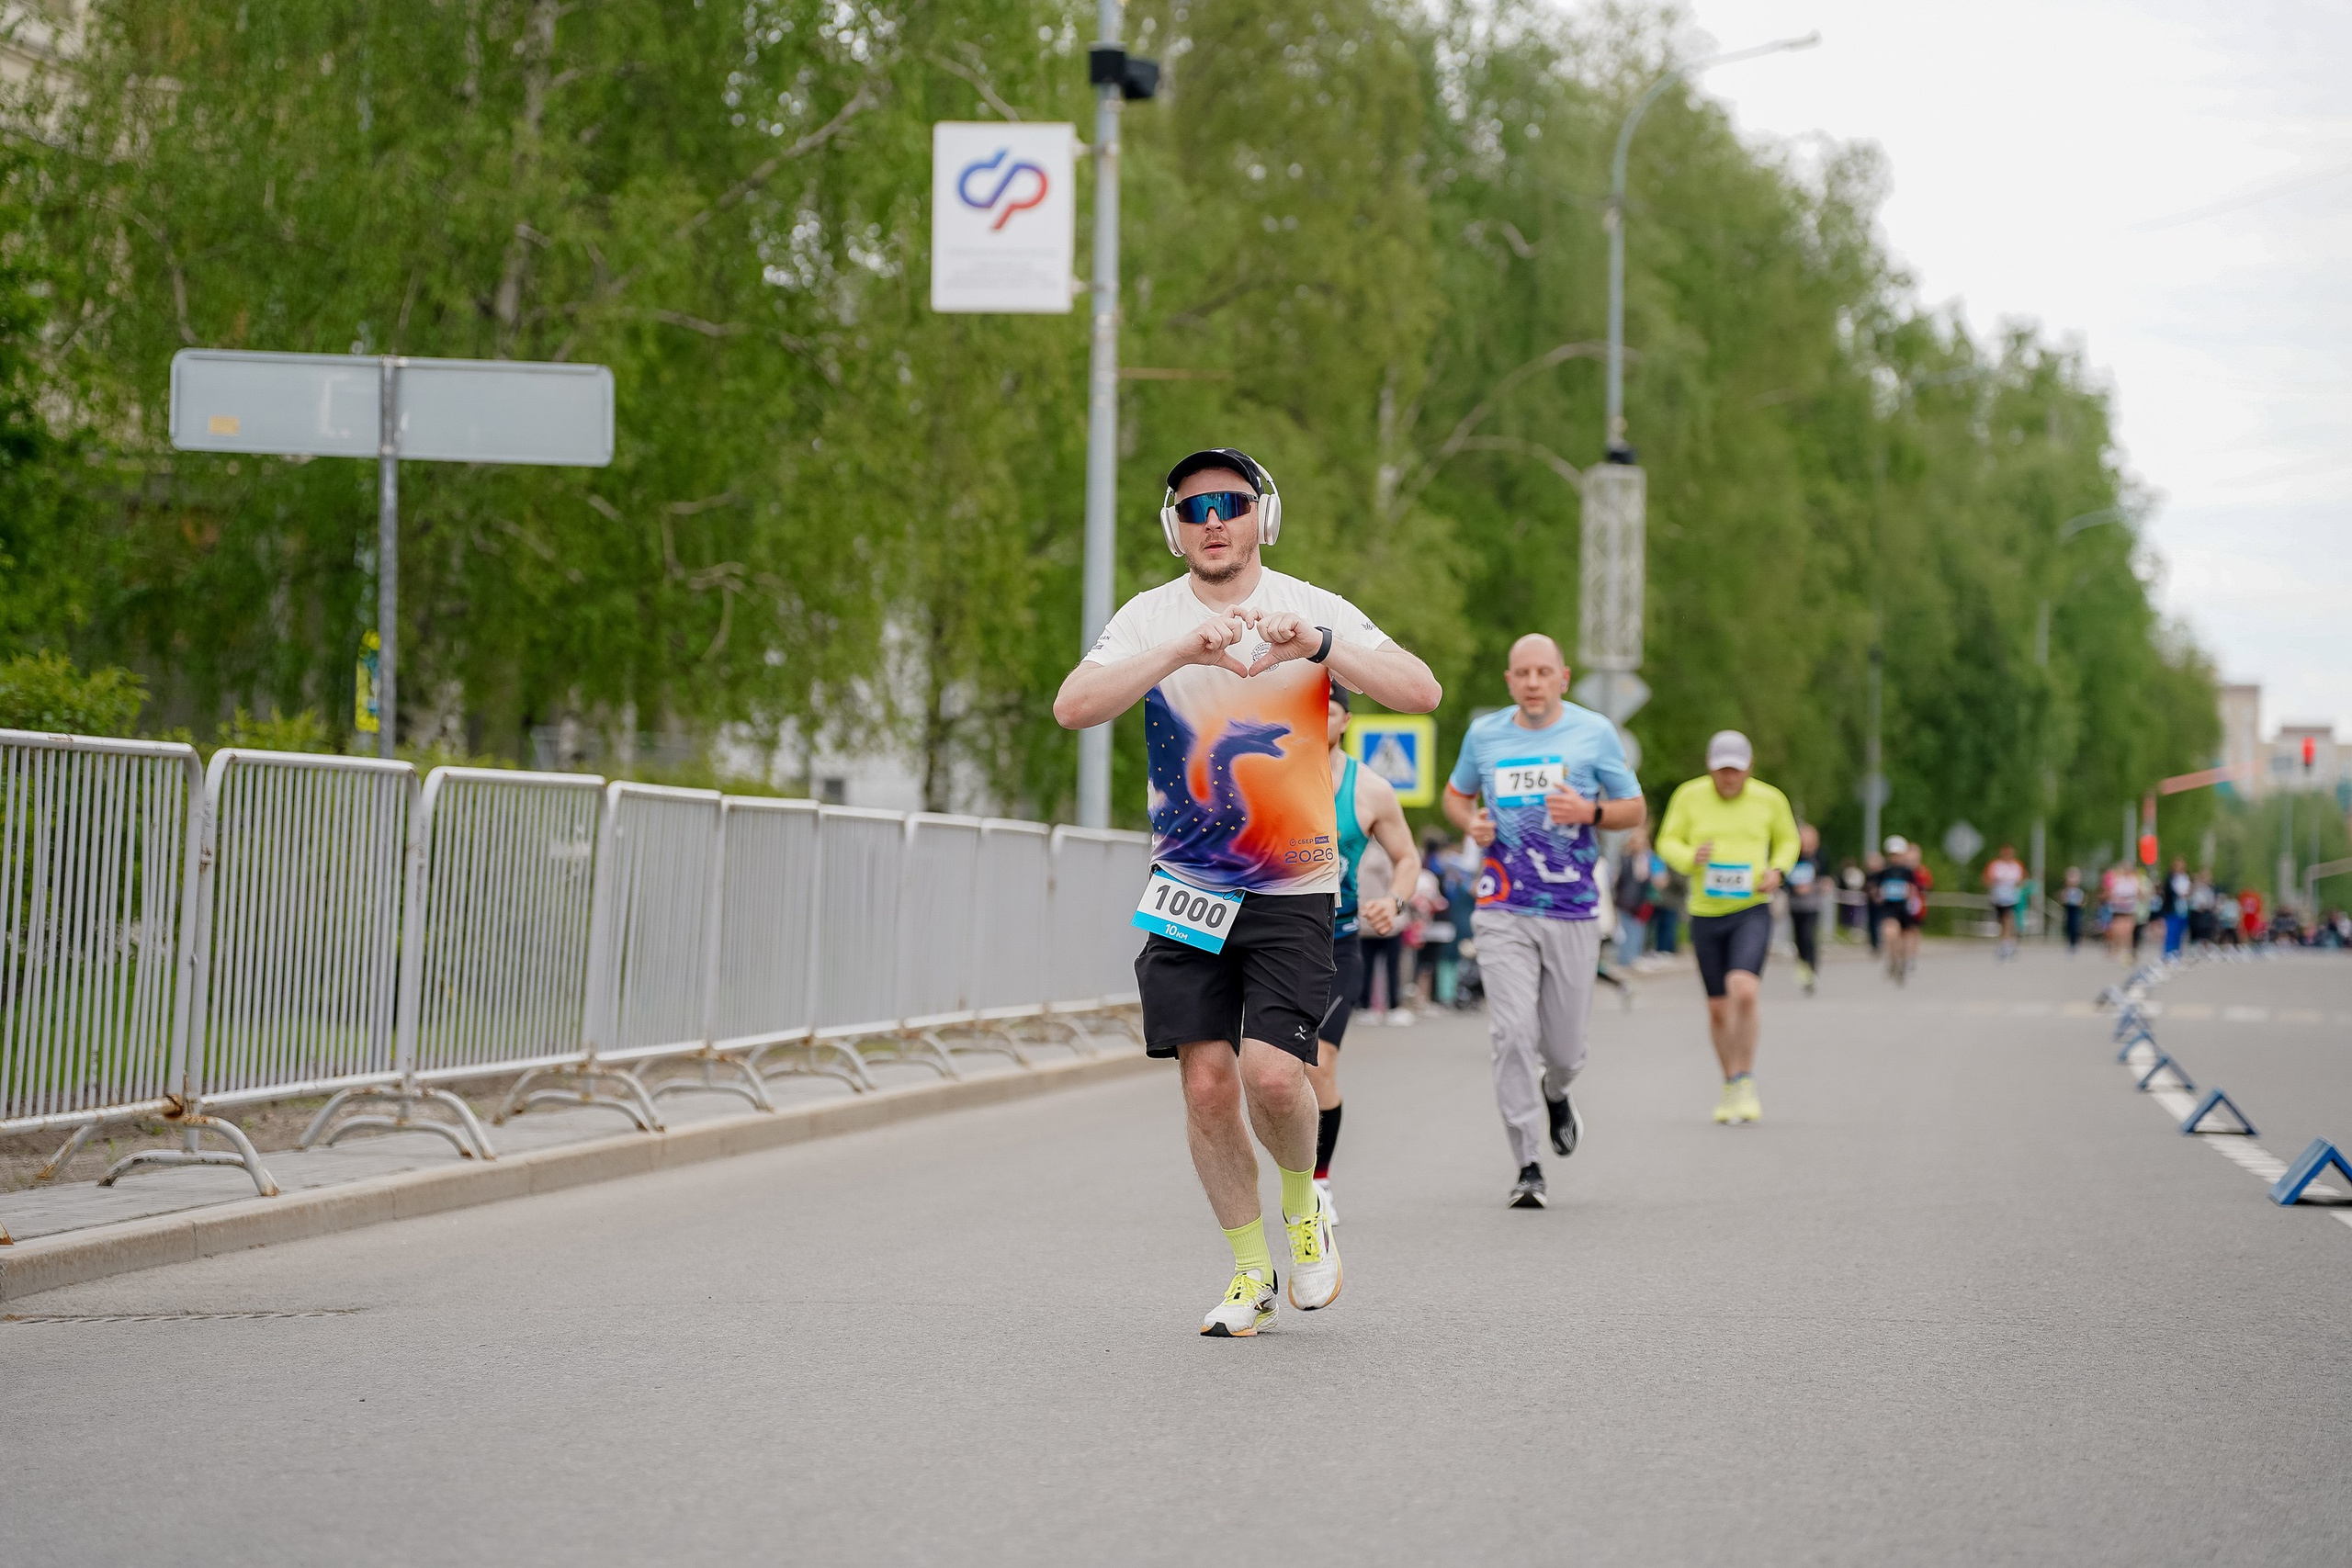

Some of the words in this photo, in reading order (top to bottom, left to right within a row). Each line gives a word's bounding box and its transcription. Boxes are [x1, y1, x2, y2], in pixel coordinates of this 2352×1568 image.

[1510, 771, 1548, 791] 756
[1284, 847, 1334, 863] 2026
[1155, 884, 1227, 929] 1000
